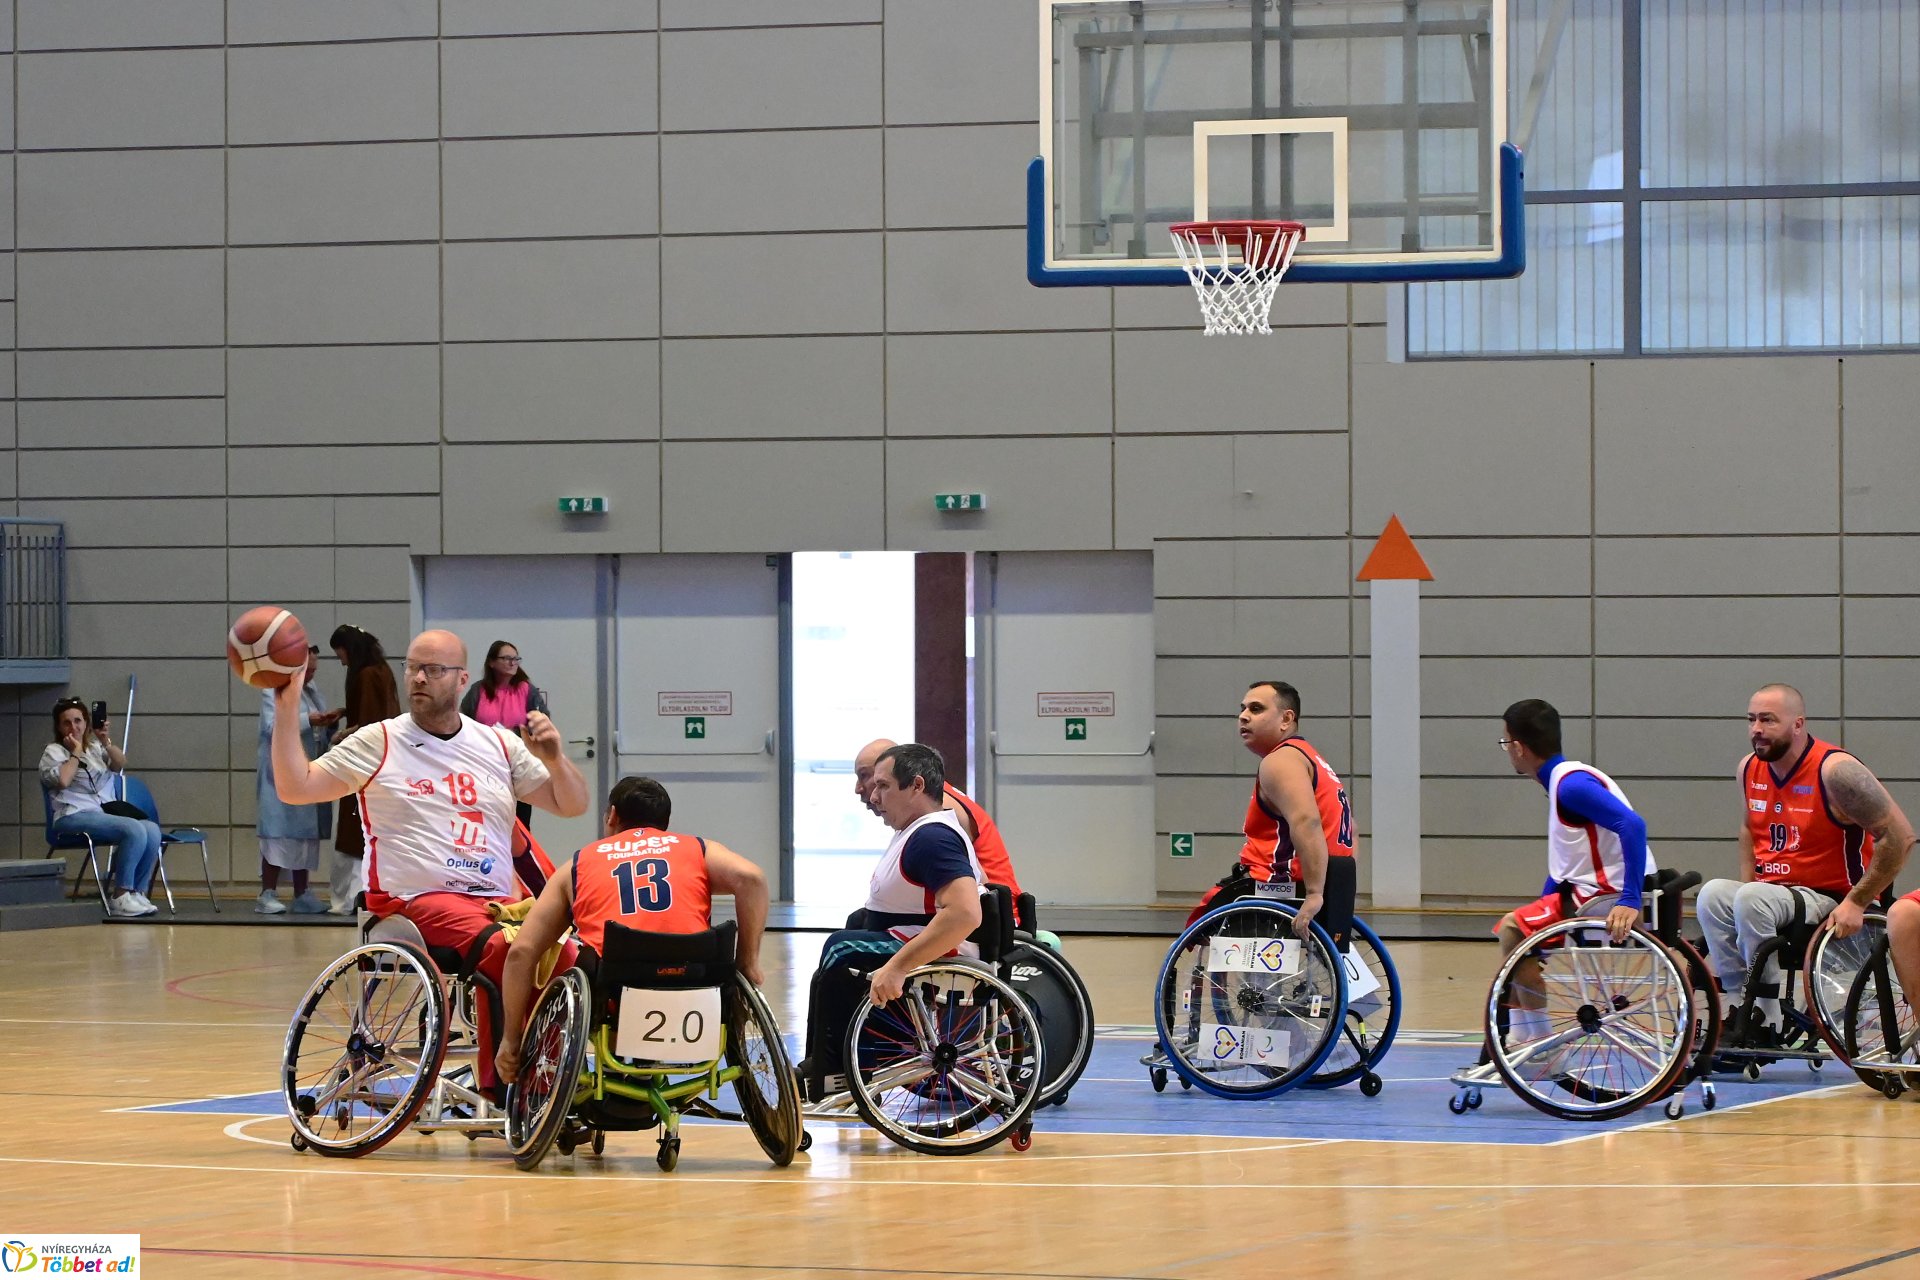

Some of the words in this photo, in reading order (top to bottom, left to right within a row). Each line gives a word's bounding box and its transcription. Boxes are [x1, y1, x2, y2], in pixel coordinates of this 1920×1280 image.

[442, 773, 478, 806] 18
[597, 836, 680, 853] SUPER
[1769, 823, 1787, 852] 19
[446, 858, 479, 869] Oplus
[607, 846, 670, 860] FOUNDATION
[1764, 862, 1791, 874] BRD
[611, 858, 672, 915] 13
[1342, 955, 1359, 983] .0
[642, 1010, 704, 1043] 2.0
